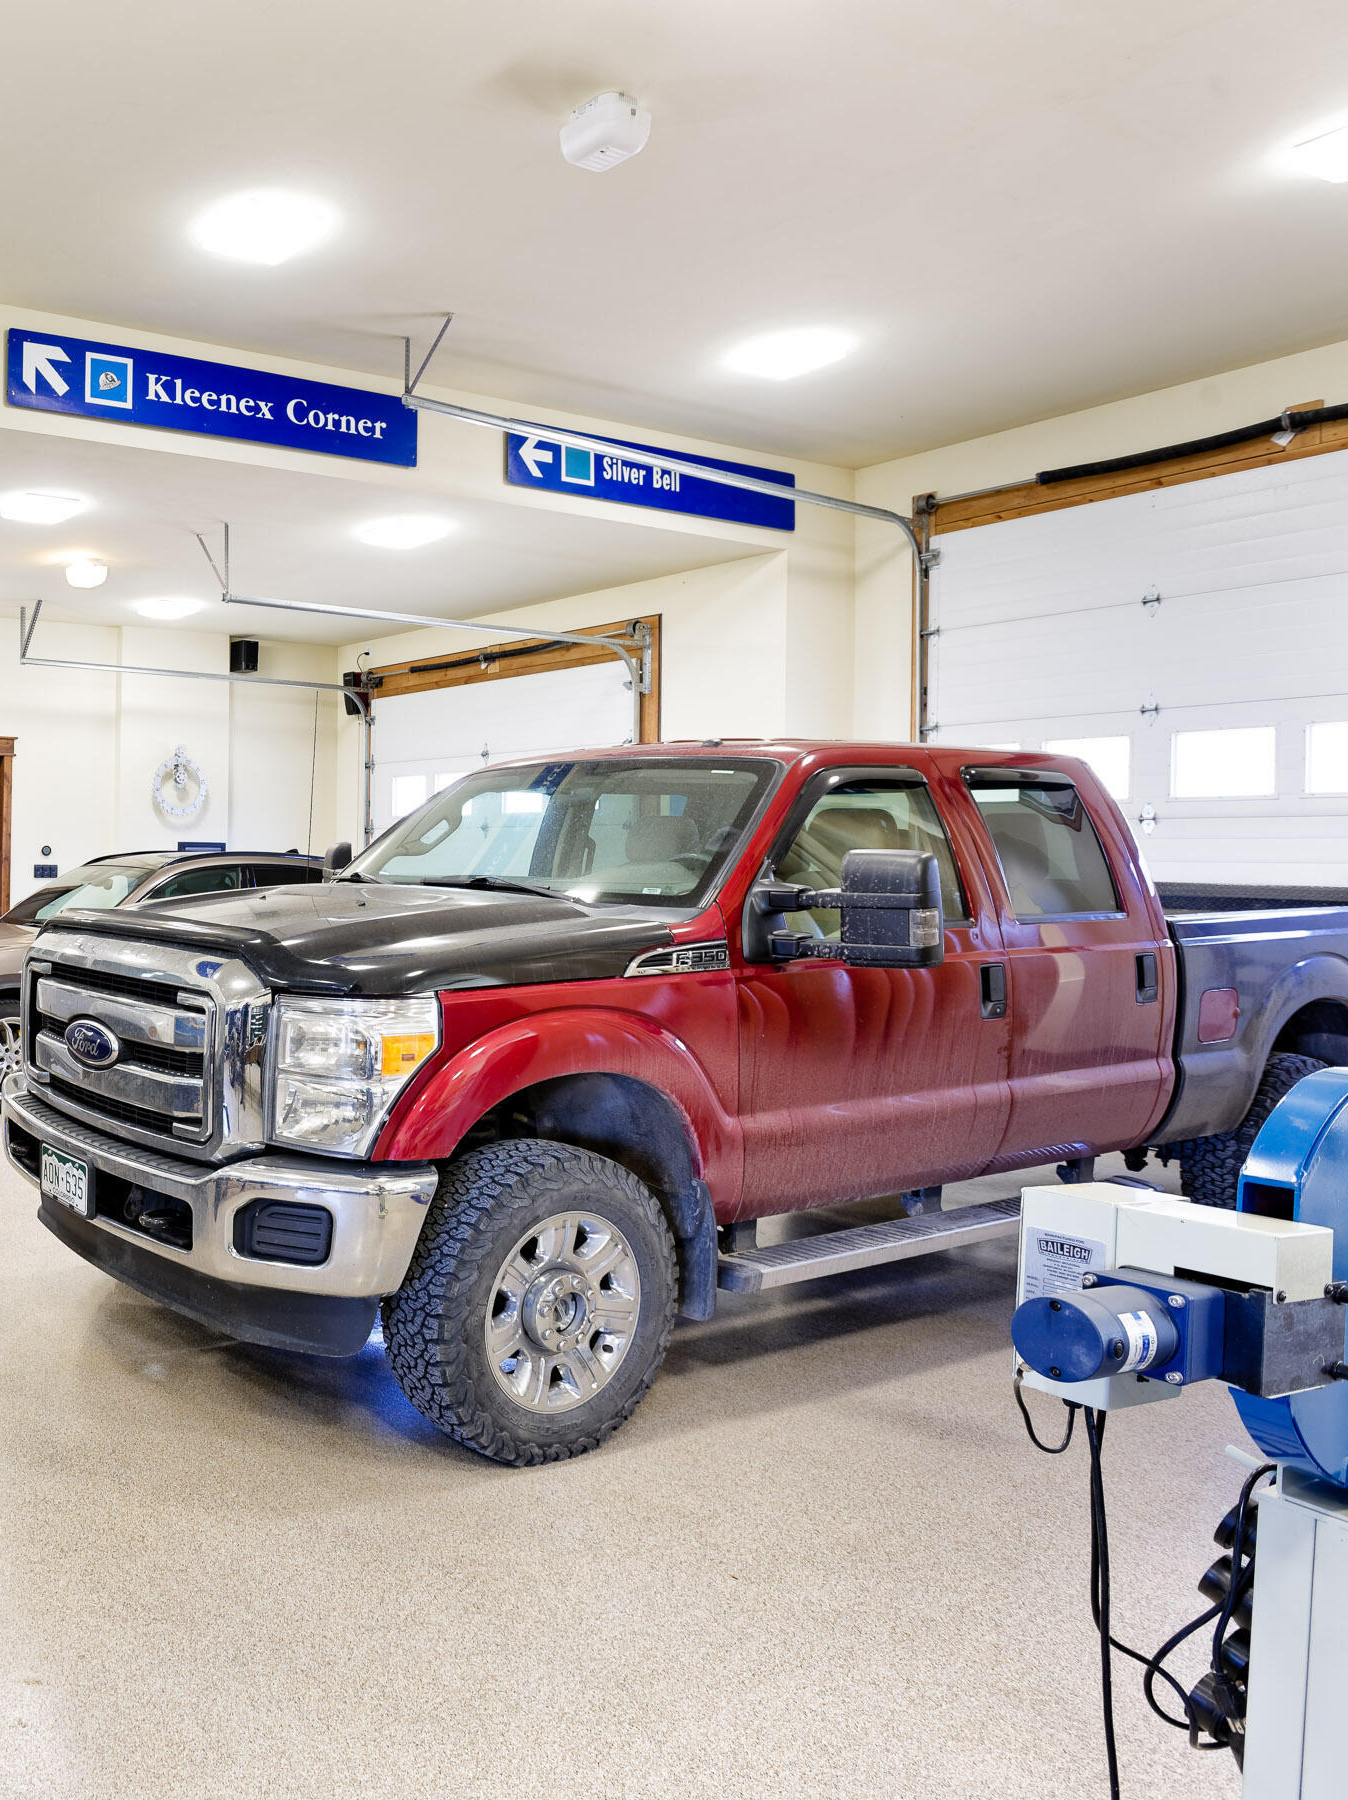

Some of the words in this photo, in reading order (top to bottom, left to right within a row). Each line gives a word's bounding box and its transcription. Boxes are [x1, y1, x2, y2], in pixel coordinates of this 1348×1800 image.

[145, 373, 274, 420] Kleenex
[286, 398, 387, 439] Corner
[602, 456, 646, 486] Silver
[652, 466, 680, 492] Bell
[72, 1027, 100, 1056] Ford
[1040, 1240, 1089, 1260] BAILEIGH
